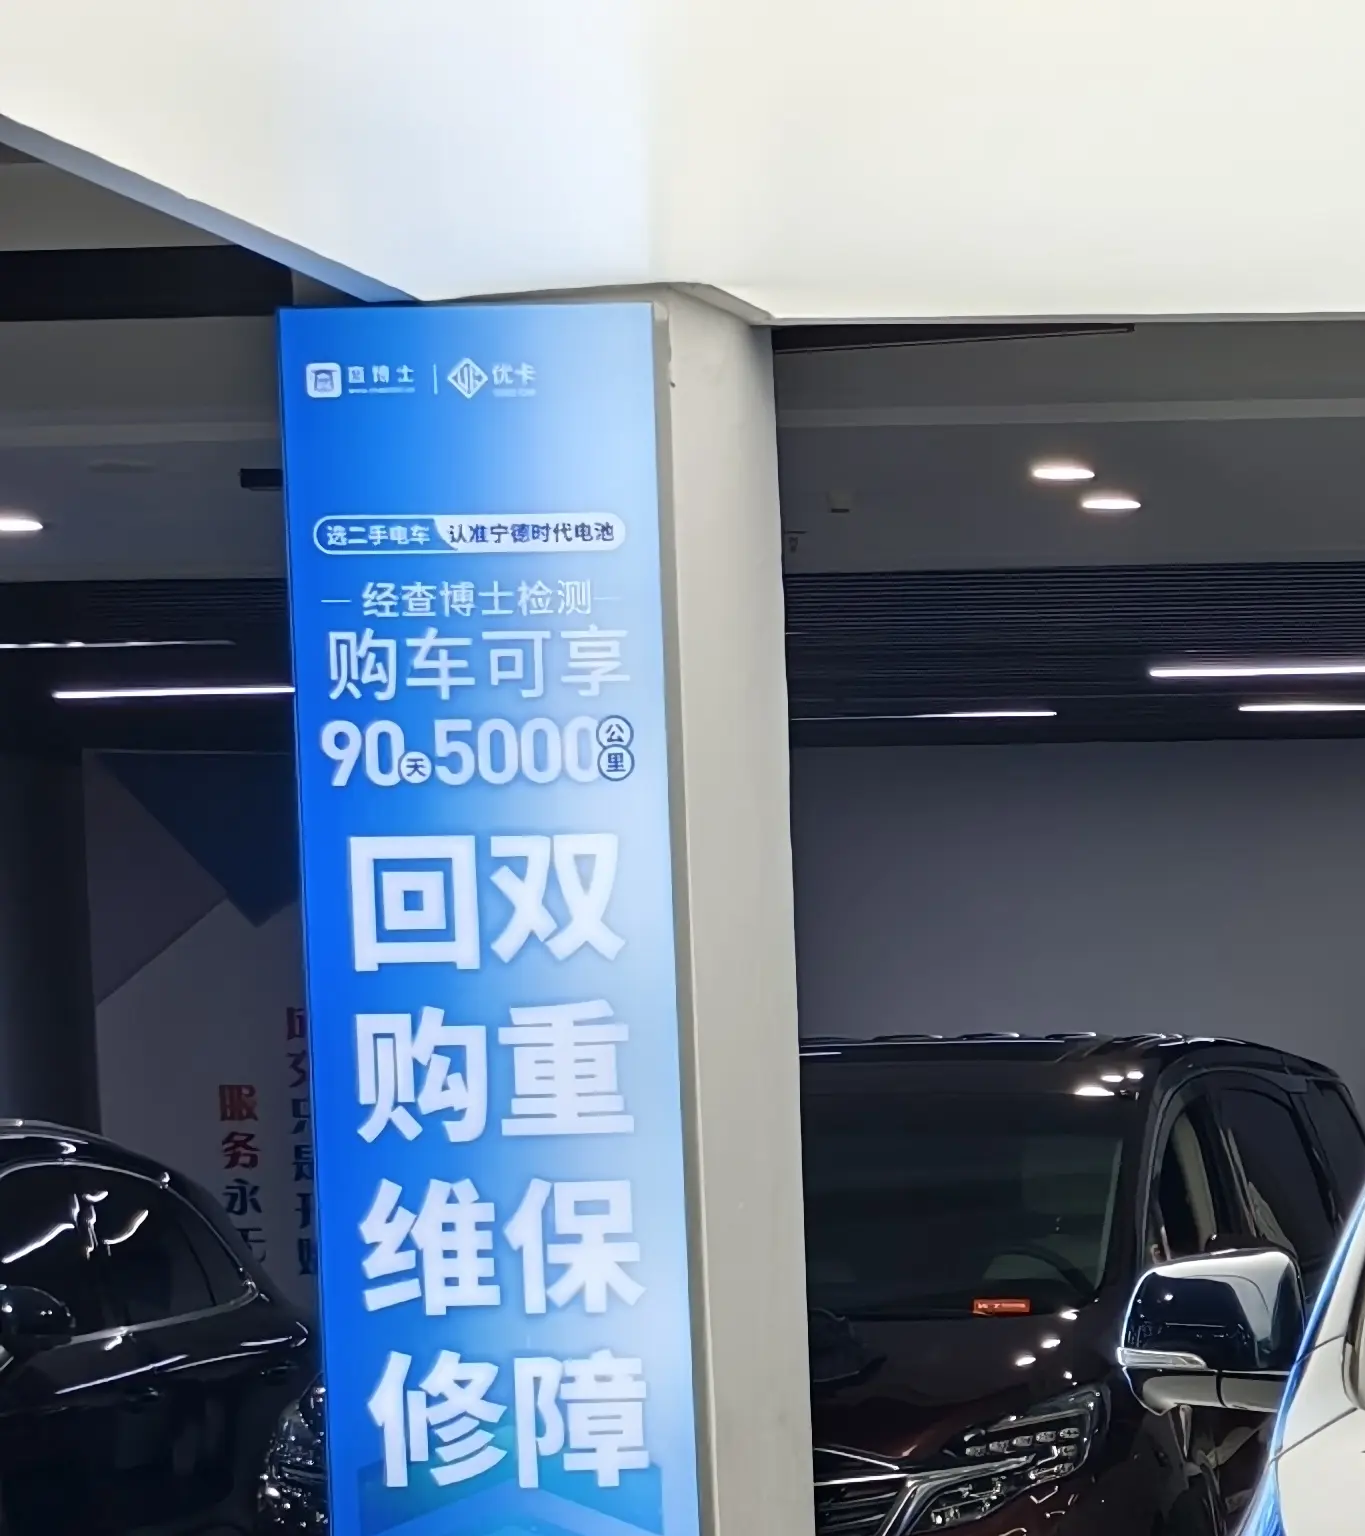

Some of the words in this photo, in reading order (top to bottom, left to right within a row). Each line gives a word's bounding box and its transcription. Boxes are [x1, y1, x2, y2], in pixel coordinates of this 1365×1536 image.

[326, 524, 431, 547] 选二手电车
[448, 521, 616, 545] 认准宁德时代电池
[361, 580, 592, 618] 经查博士检测
[327, 623, 631, 702] 购车可享
